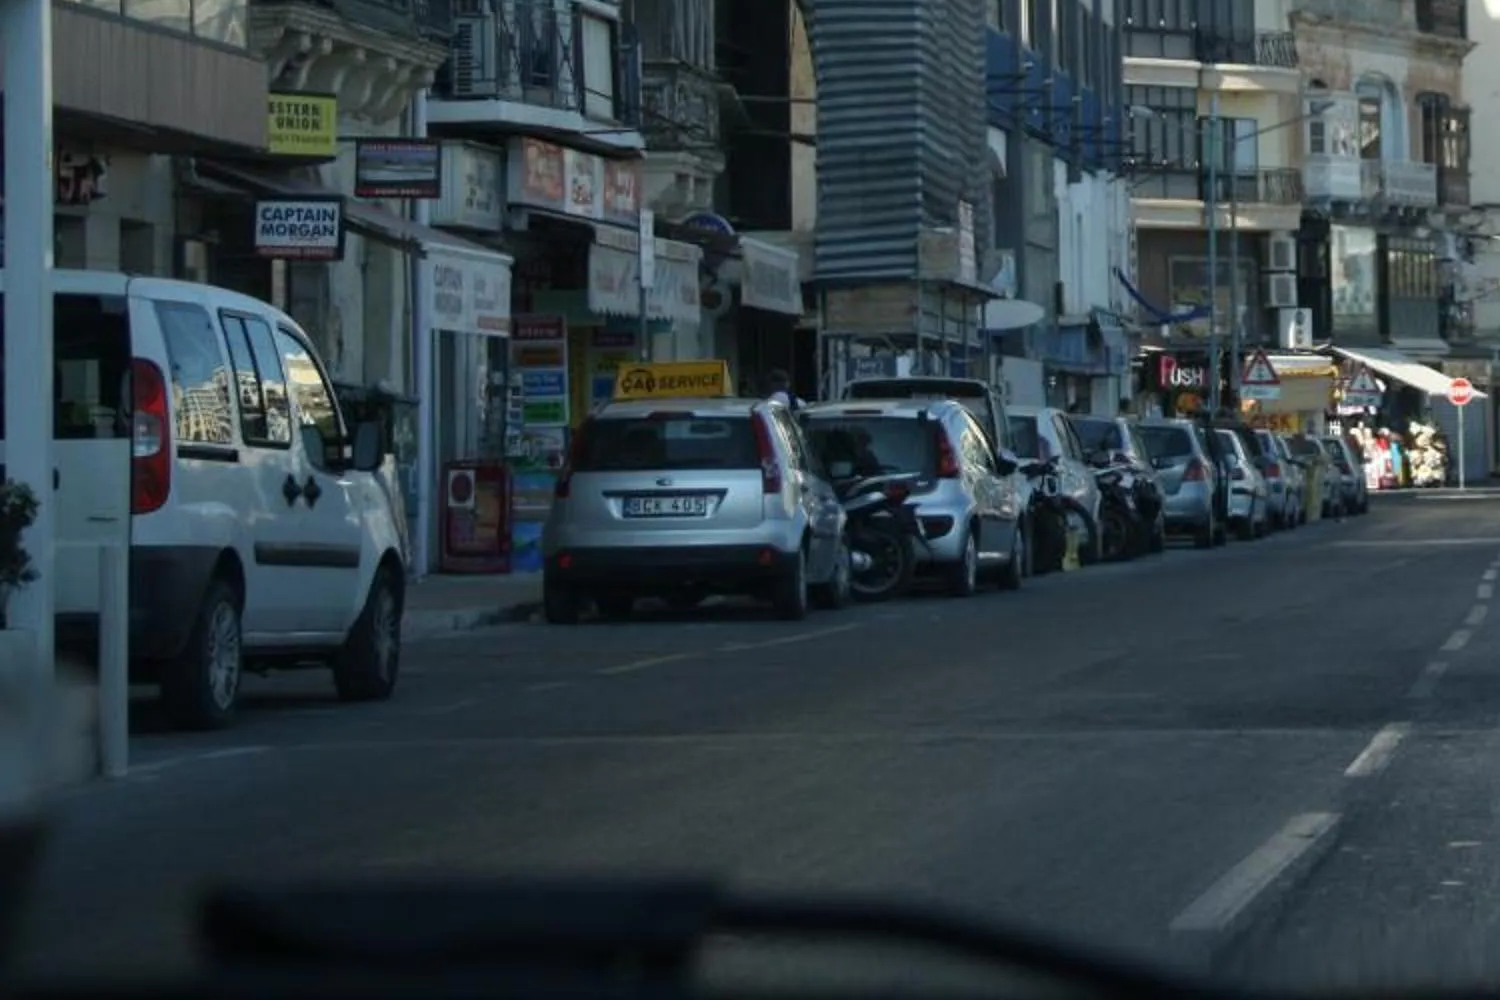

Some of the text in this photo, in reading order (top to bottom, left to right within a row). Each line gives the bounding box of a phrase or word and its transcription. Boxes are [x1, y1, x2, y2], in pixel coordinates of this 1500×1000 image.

[267, 101, 320, 117] ESTERN
[276, 117, 320, 131] UNION
[261, 206, 335, 222] CAPTAIN
[261, 223, 335, 237] MORGAN
[658, 372, 720, 390] SERVICE
